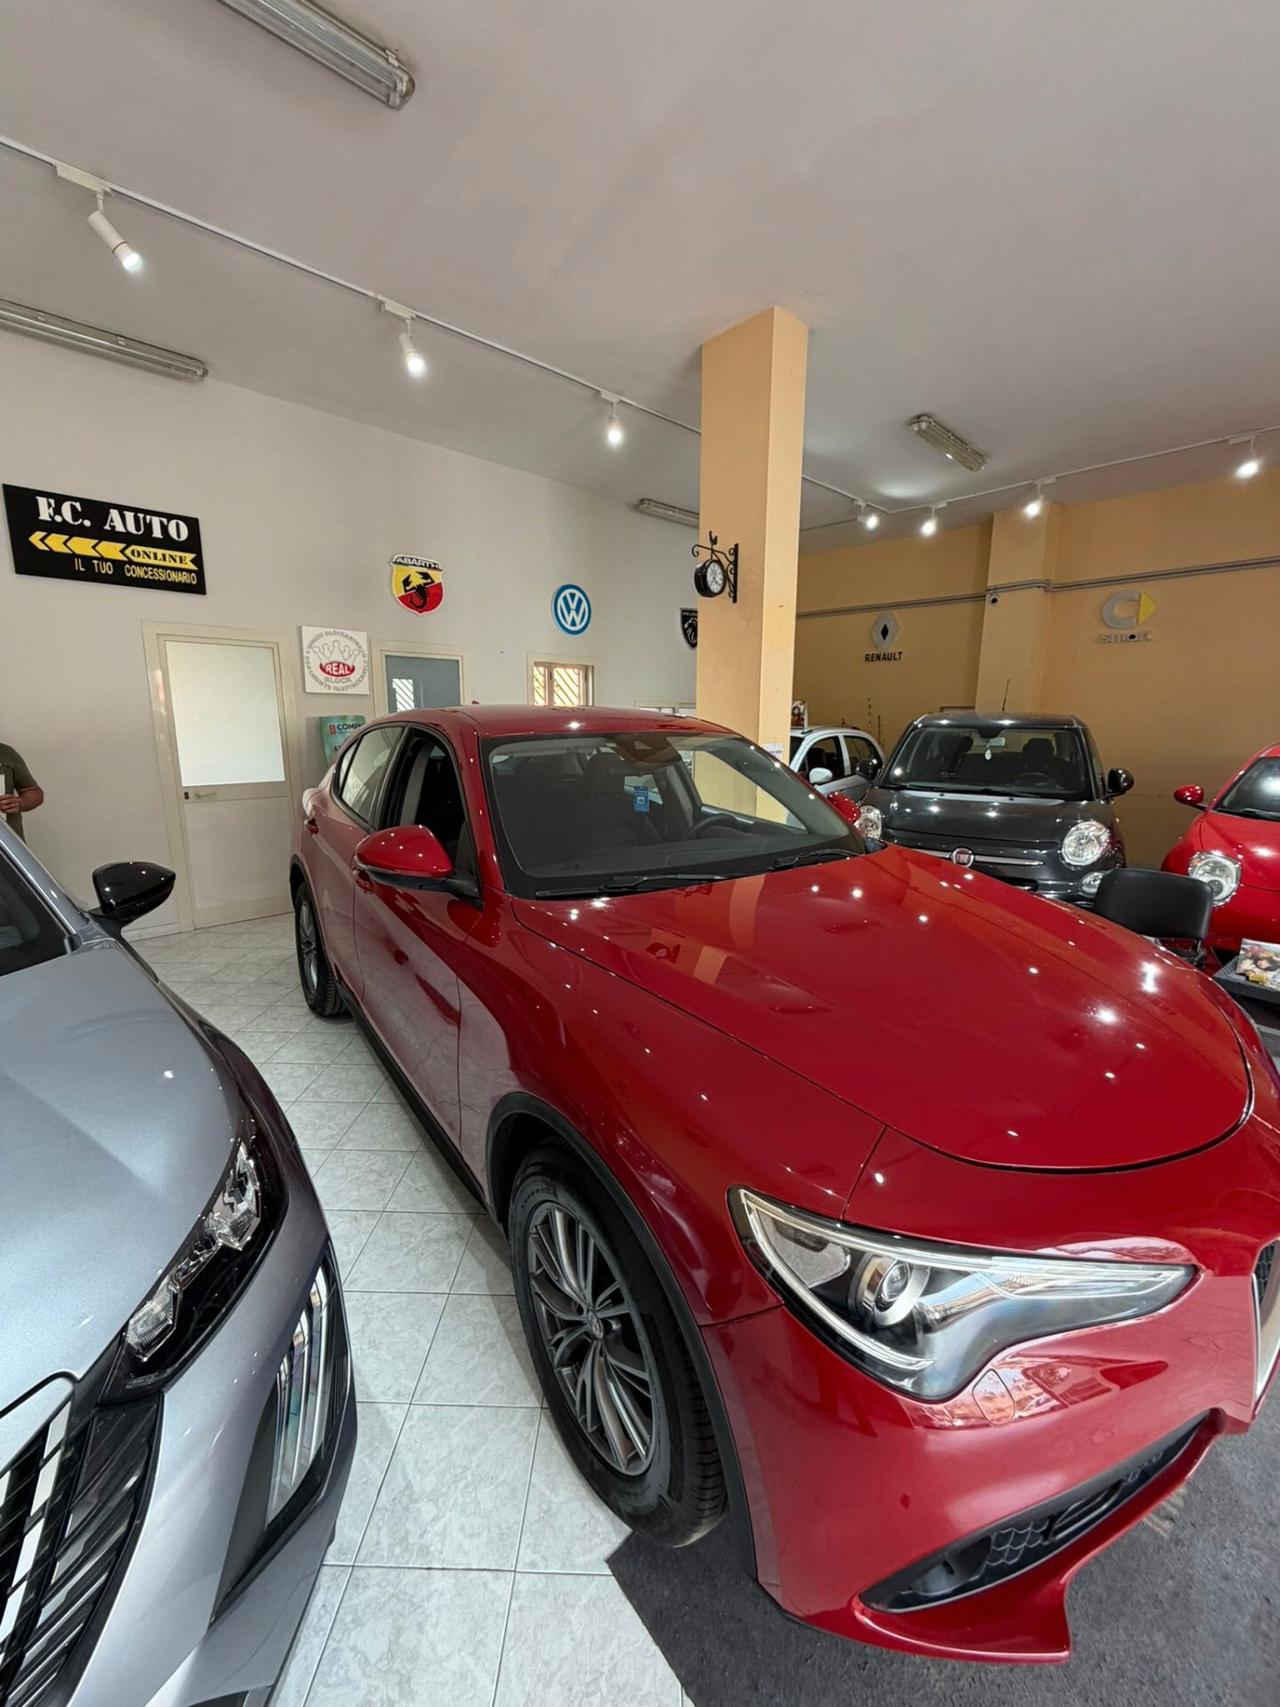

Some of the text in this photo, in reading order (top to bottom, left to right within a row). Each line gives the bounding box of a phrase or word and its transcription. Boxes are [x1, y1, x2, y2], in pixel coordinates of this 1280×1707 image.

[36, 496, 189, 541] F.C. AUTO
[131, 548, 188, 565] ONLINE
[396, 557, 439, 568] ABARTH
[75, 558, 196, 584] IL TUO CONCESSIONARIO
[864, 651, 903, 662] RENAULT
[325, 663, 350, 675] REAL
